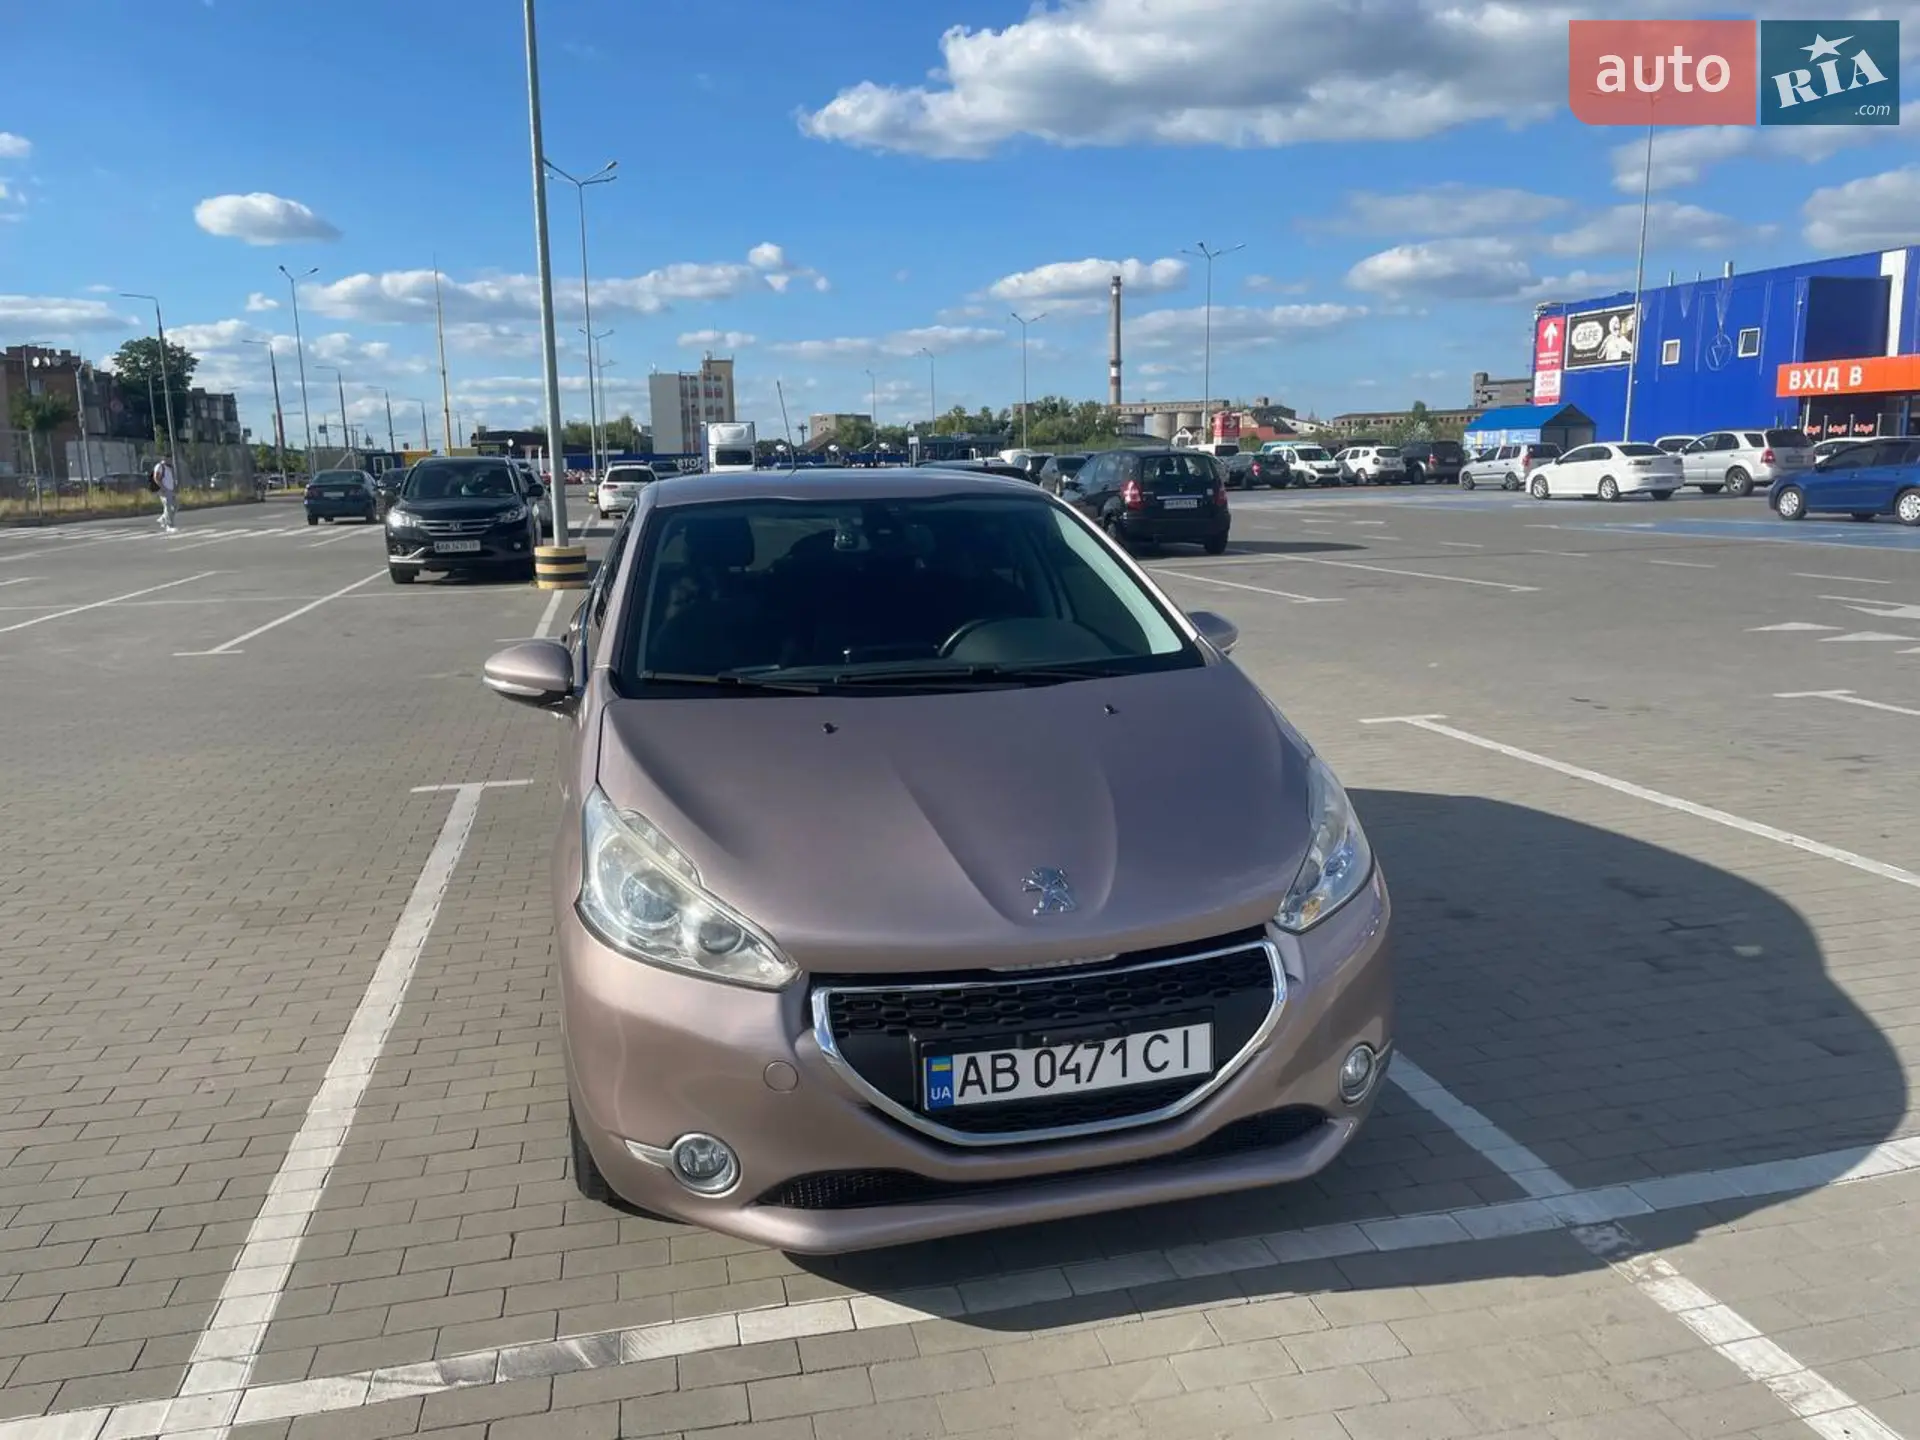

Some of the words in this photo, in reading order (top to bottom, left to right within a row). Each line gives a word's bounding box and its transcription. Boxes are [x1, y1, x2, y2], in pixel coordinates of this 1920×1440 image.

[1788, 366, 1839, 391] ВХІД
[958, 1053, 1020, 1098] AB
[1034, 1039, 1128, 1088] 0471
[1142, 1029, 1189, 1073] CI
[930, 1086, 952, 1101] UA
